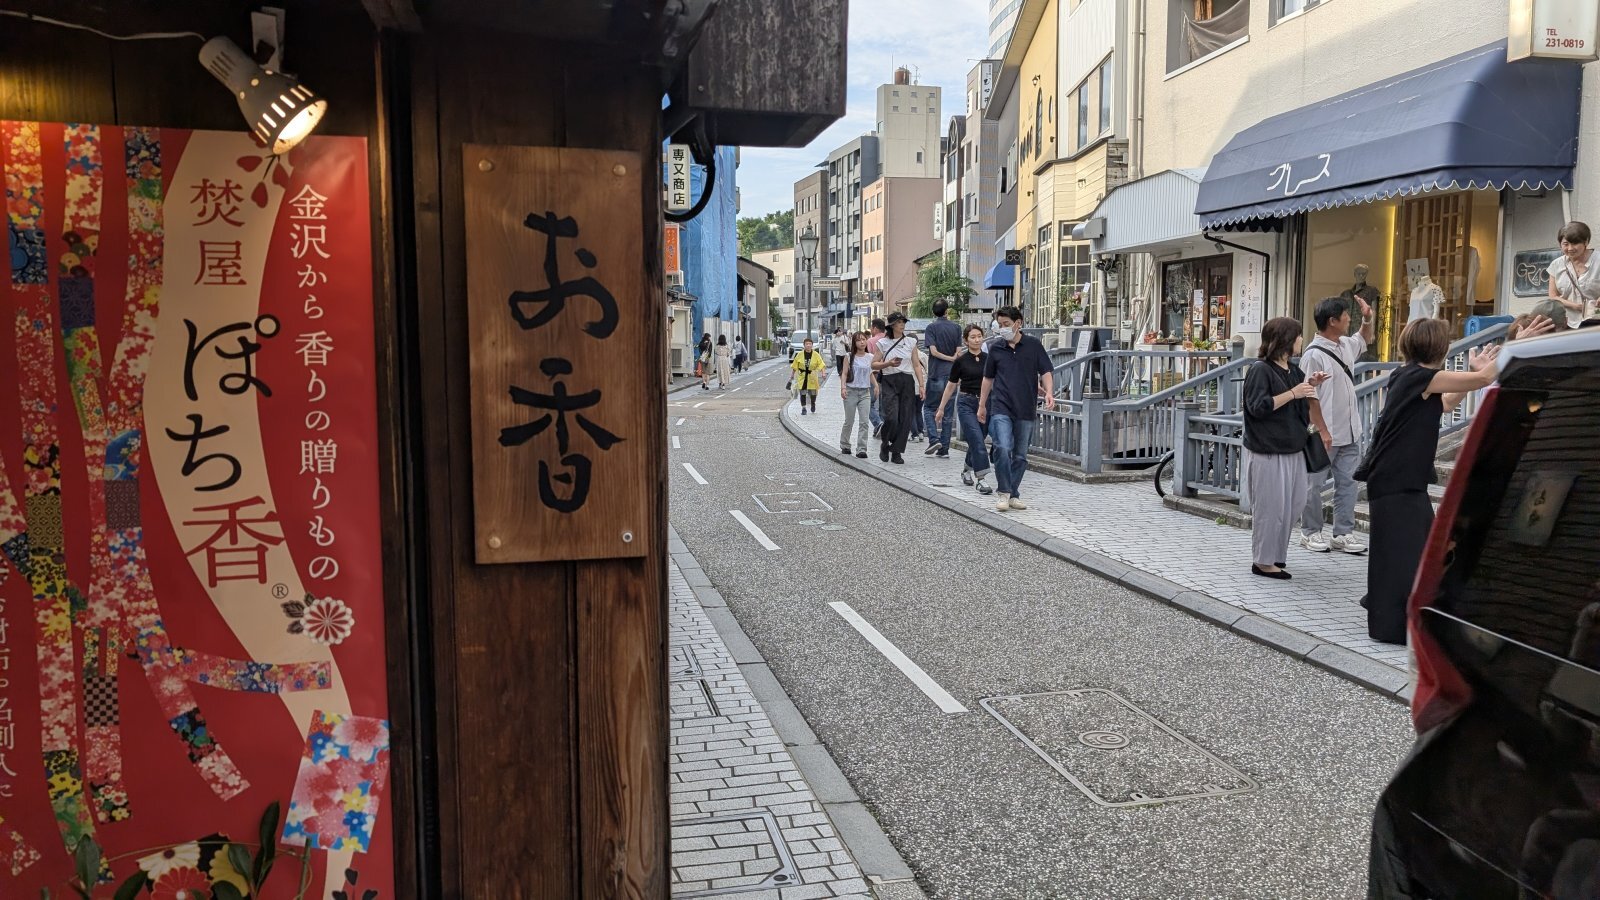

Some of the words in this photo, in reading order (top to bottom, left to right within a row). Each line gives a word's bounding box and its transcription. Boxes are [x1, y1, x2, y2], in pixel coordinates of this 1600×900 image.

[1545, 38, 1585, 49] 231-0819
[1546, 28, 1558, 36] TEL
[673, 148, 685, 205] 専又商店
[190, 178, 248, 286] 焚屋
[288, 184, 340, 581] 金沢から香りの贈りもの
[497, 211, 627, 514] お香
